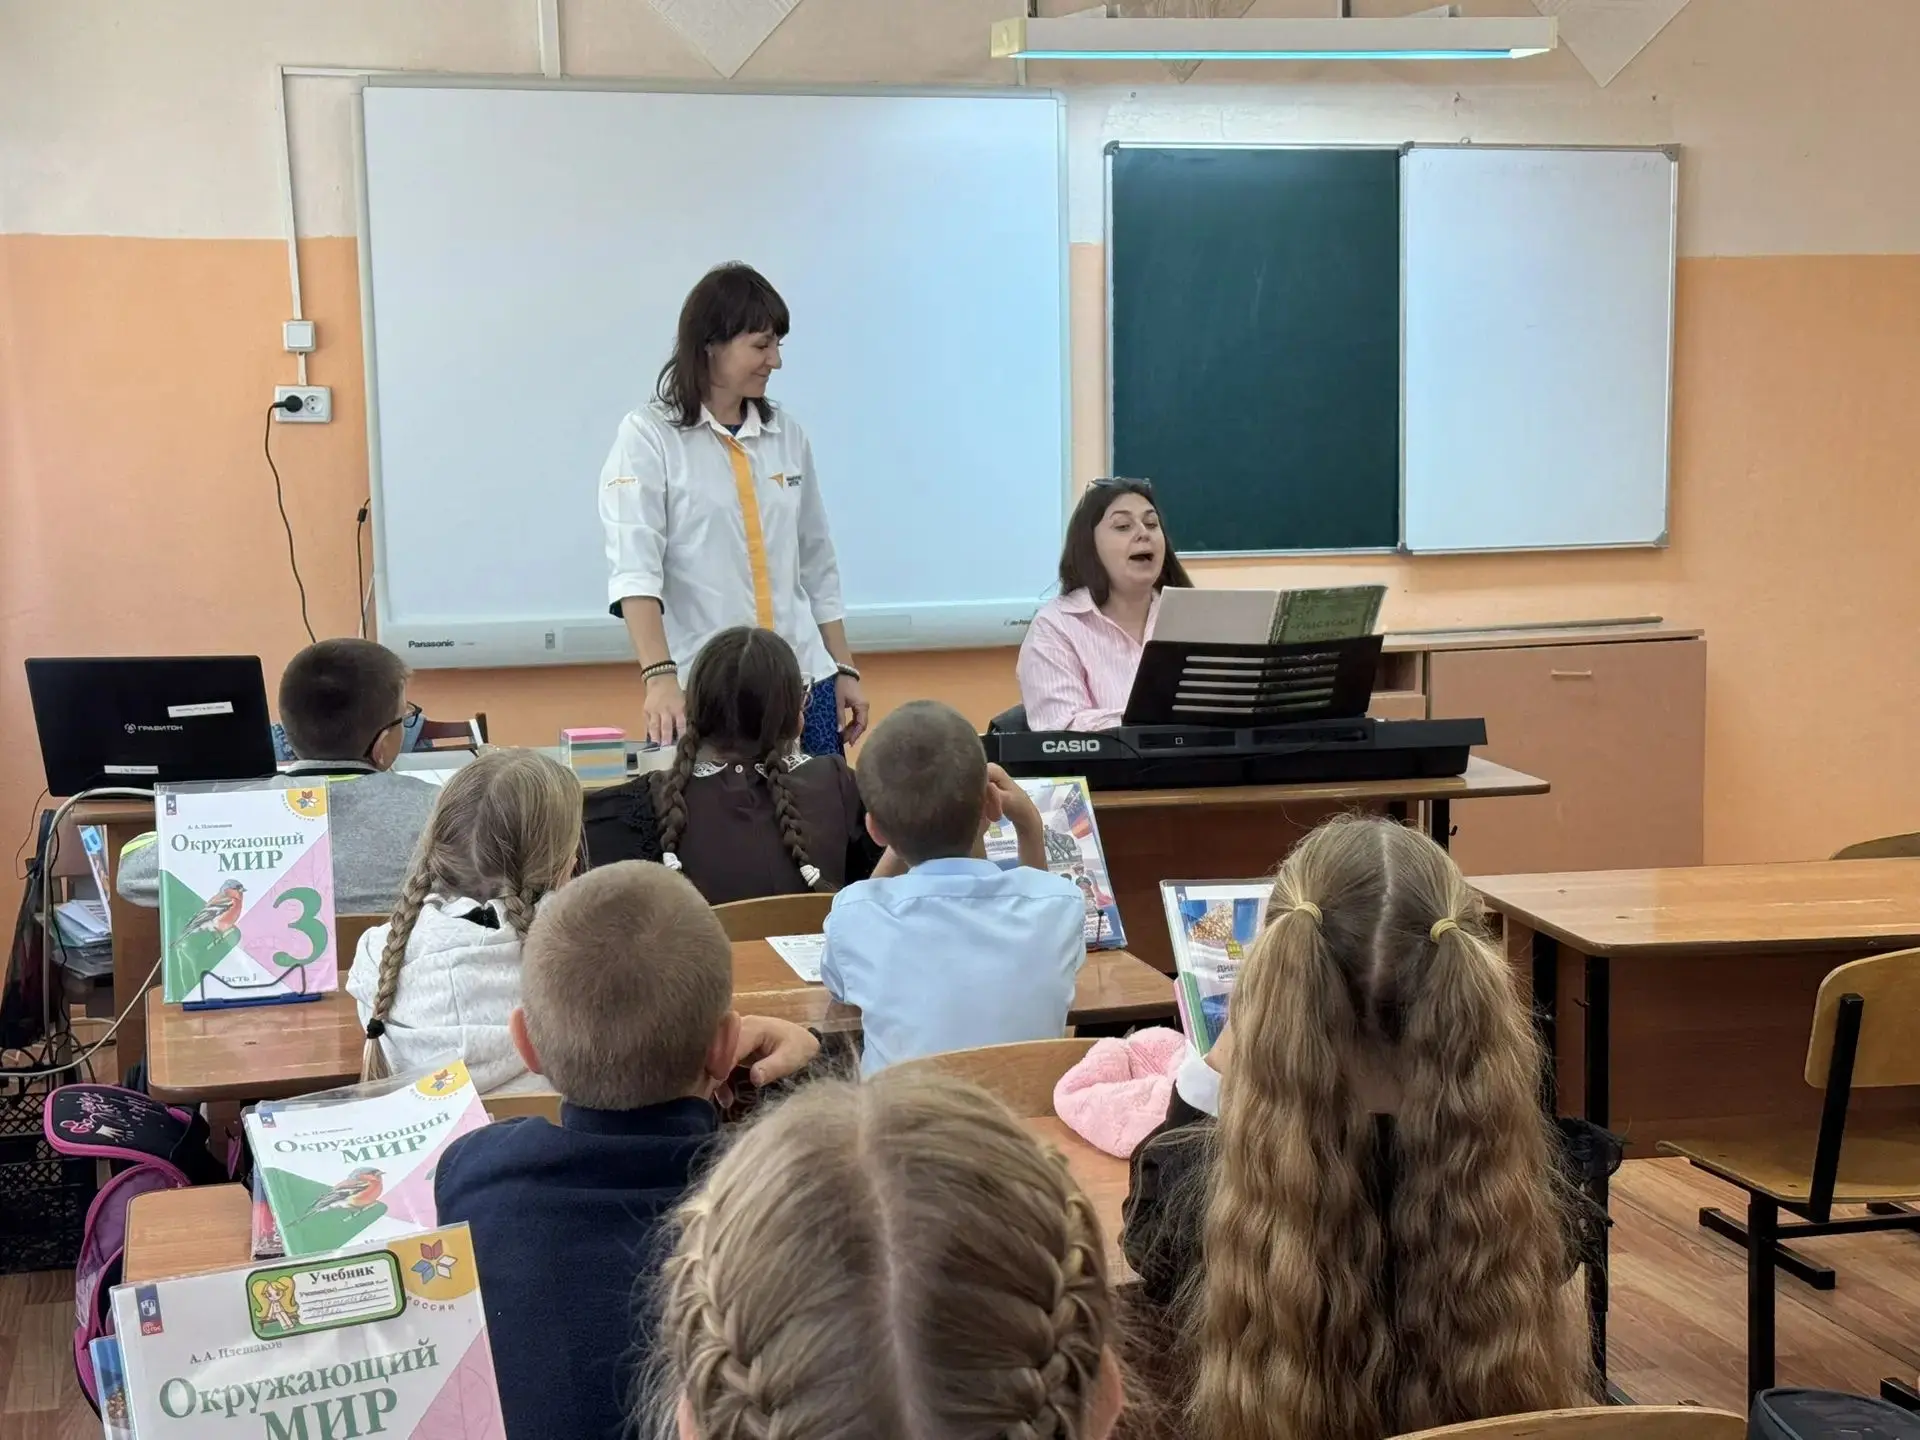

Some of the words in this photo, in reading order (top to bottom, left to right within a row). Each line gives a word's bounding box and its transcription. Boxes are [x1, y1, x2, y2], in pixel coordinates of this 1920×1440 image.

[408, 639, 455, 648] Panasonic
[1042, 739, 1100, 753] CASIO
[171, 831, 304, 854] Окружающий
[217, 849, 284, 873] МИР
[272, 886, 328, 967] 3
[273, 1111, 452, 1154] Окружающий
[341, 1133, 427, 1165] МИР
[309, 1264, 375, 1285] Учебник
[159, 1338, 440, 1418] Окружающий
[259, 1387, 398, 1440] МИР
